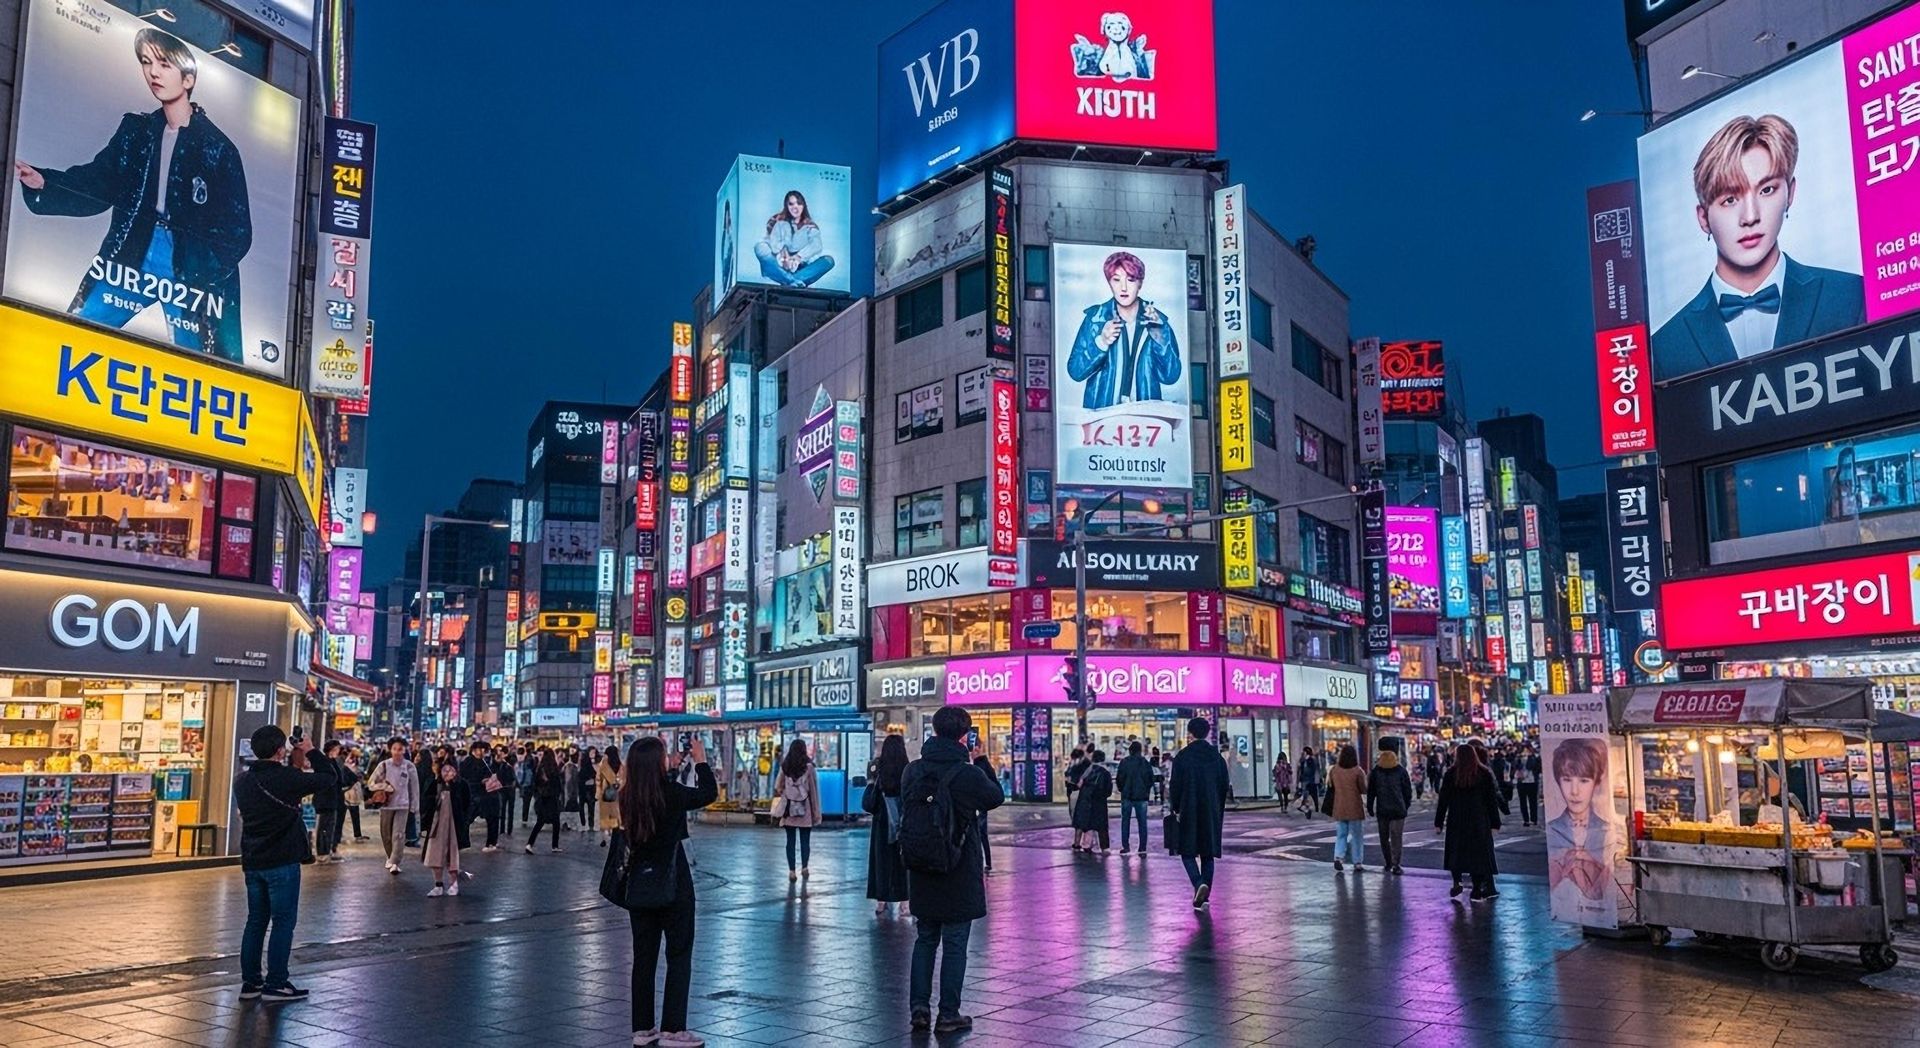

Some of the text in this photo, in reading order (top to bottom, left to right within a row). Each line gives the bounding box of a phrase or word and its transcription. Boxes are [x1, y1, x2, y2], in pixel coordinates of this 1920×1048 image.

[902, 28, 980, 117] WB
[57, 345, 253, 446] K단라만
[906, 562, 959, 592] BROK
[52, 594, 199, 654] GOM
